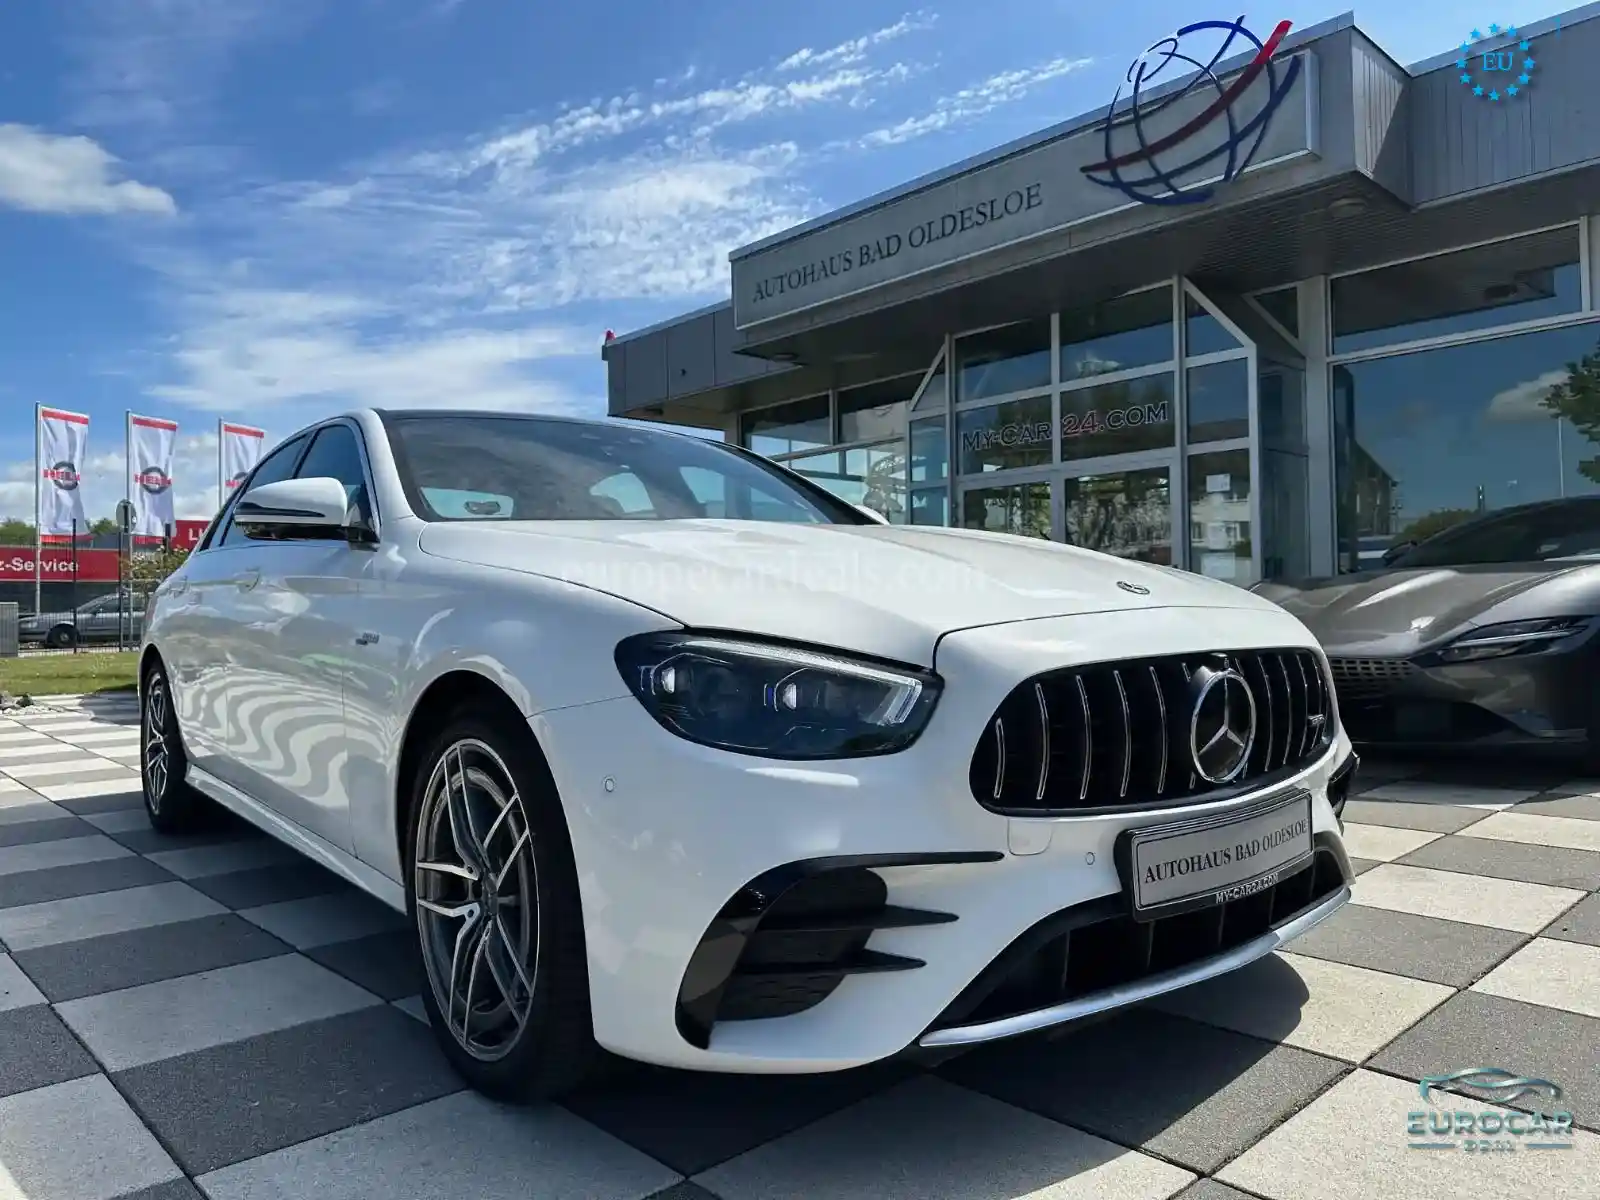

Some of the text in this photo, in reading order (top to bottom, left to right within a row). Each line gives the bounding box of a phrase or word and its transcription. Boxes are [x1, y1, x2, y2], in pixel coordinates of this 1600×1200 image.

[753, 183, 1043, 303] AUTOHAUS BAD OLDESLOE
[1144, 818, 1309, 884] AUTOHAUS BAD OLDESLOE
